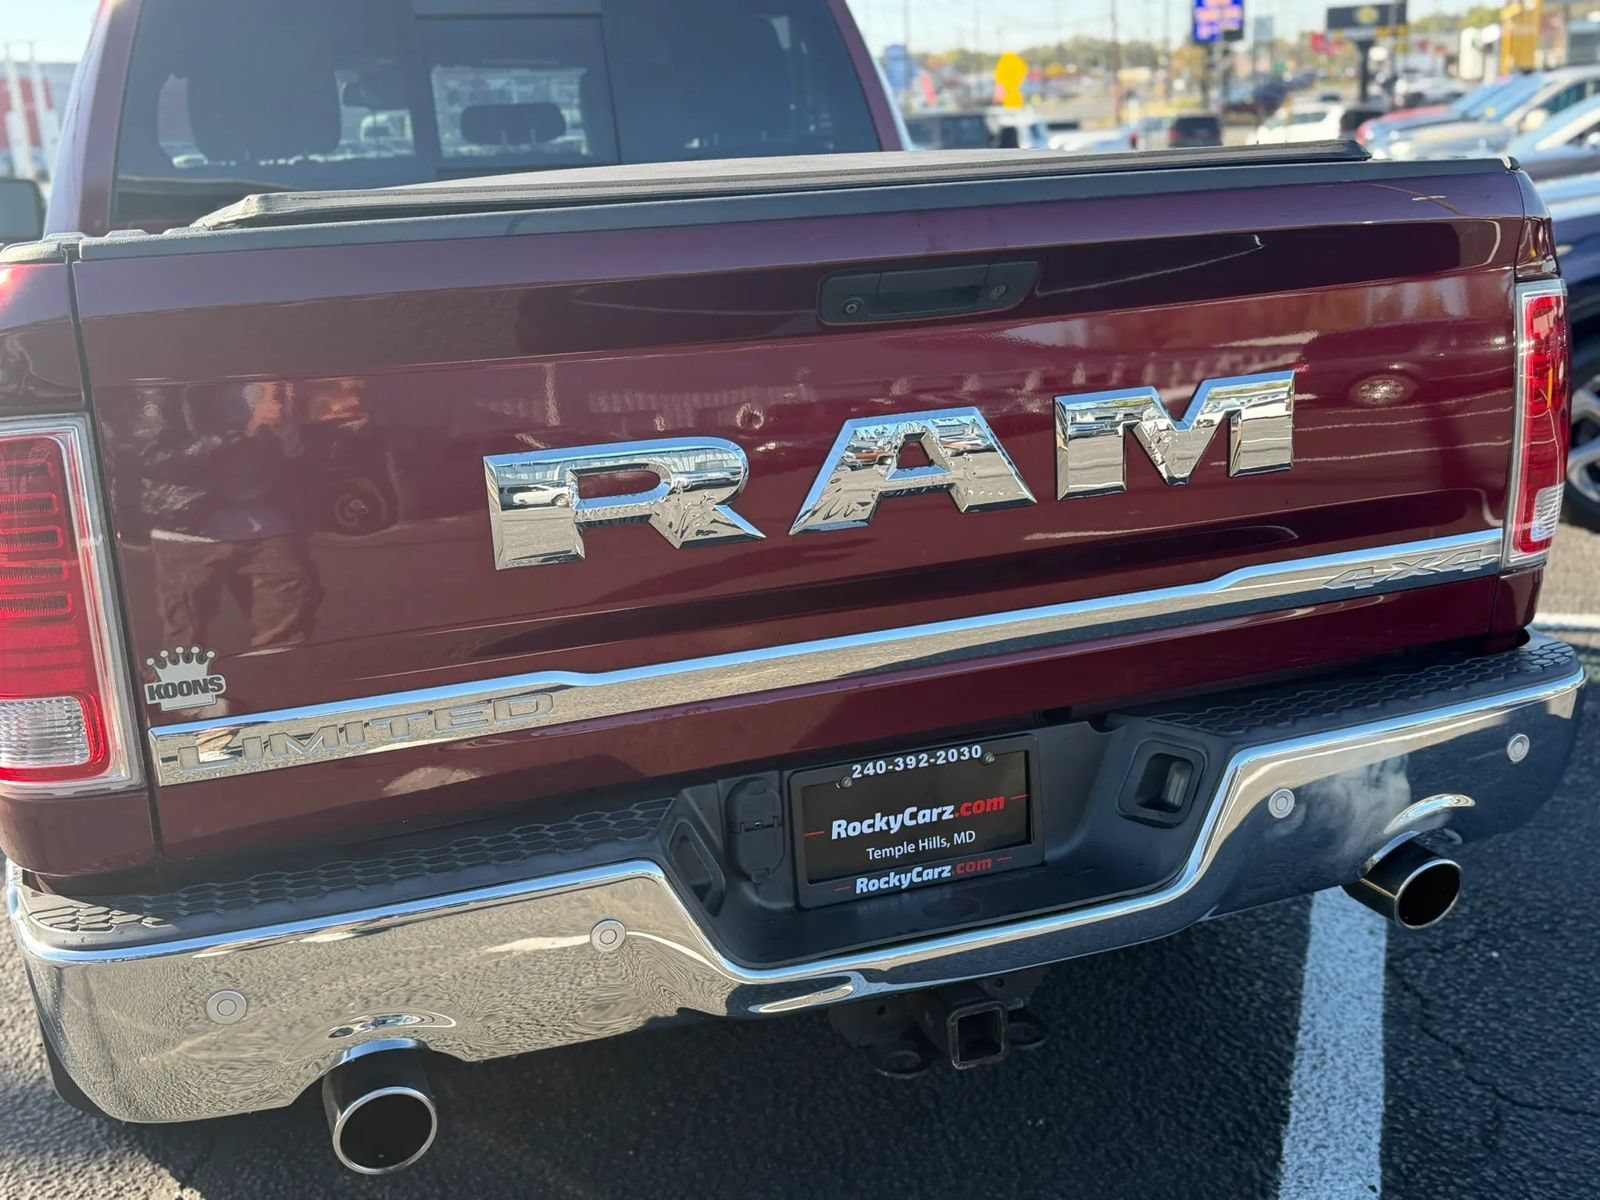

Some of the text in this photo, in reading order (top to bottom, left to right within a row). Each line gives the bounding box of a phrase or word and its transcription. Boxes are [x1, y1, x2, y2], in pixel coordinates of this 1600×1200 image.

[483, 368, 1296, 571] RAM
[147, 676, 224, 701] KOONS
[178, 693, 554, 769] LIMITED
[851, 745, 982, 778] 240-392-2030
[831, 796, 1006, 839] RockyCarz.com
[866, 830, 976, 860] Temple Hills, MD
[855, 858, 992, 894] RockyCarz.com
